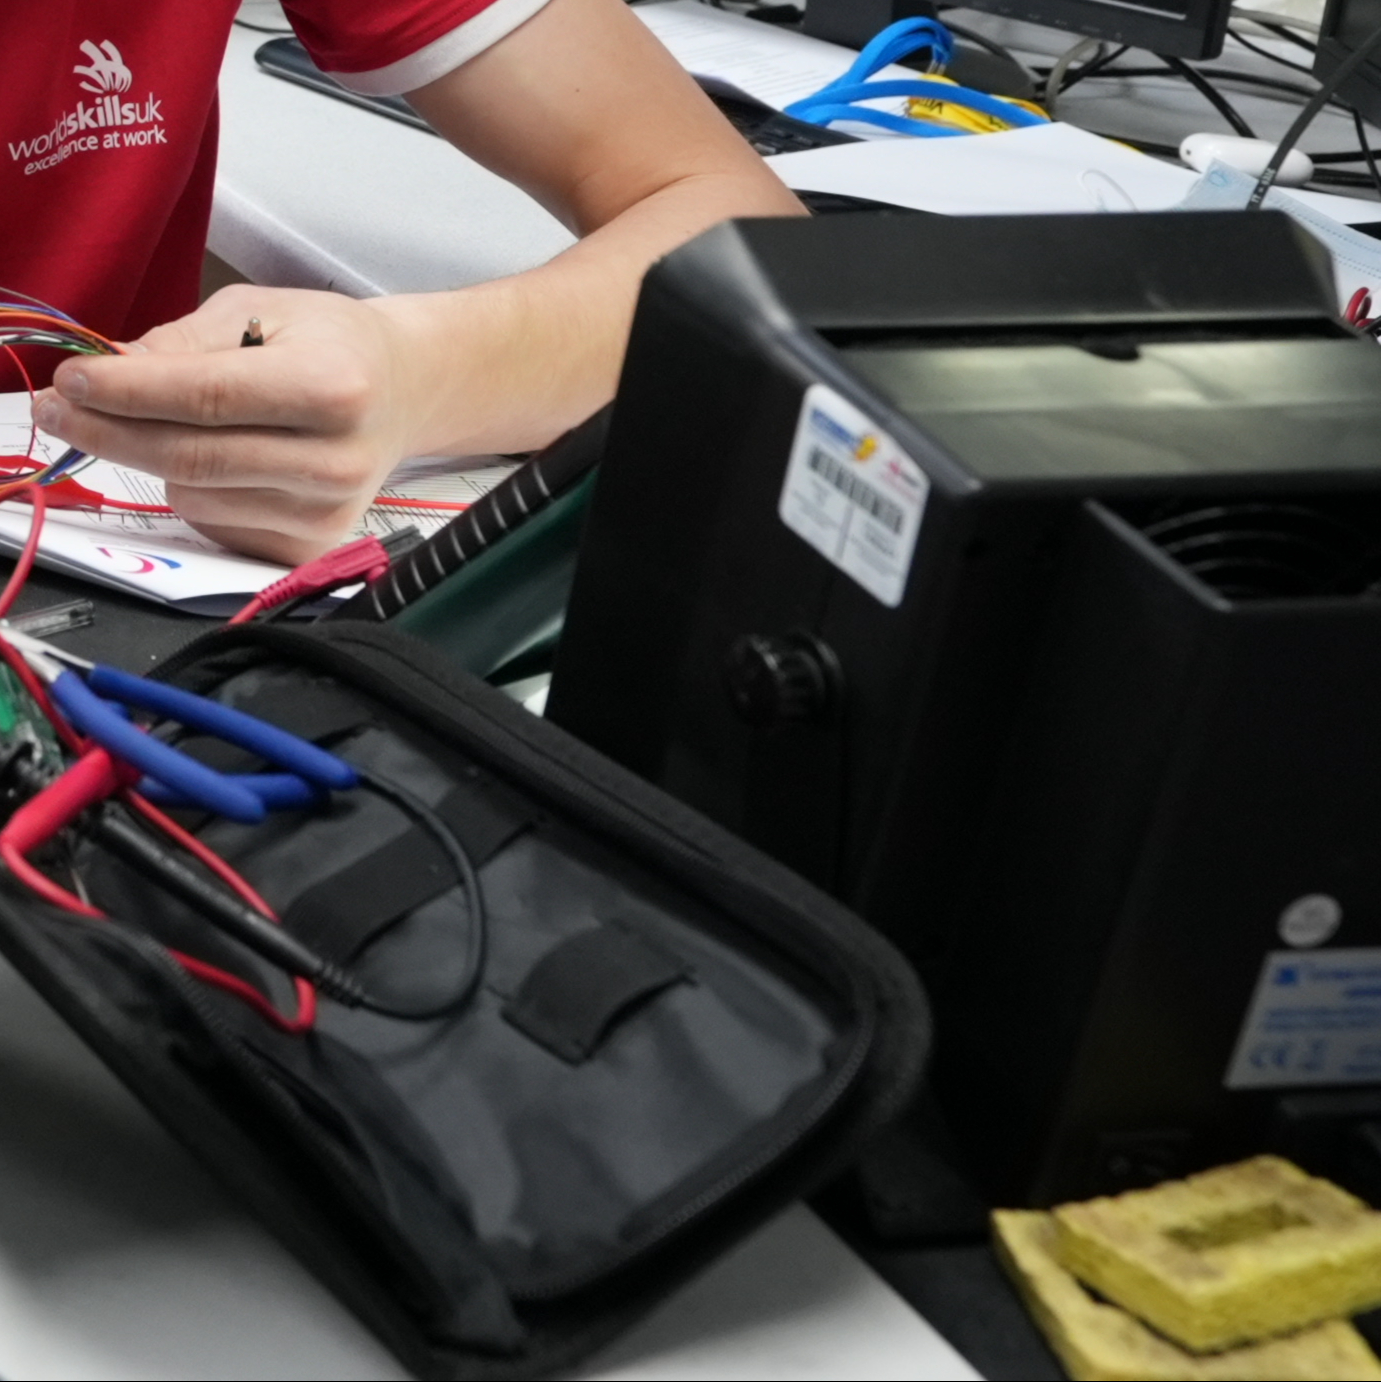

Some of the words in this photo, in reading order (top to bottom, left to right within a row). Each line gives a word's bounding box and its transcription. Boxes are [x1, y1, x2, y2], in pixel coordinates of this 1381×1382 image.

[7, 91, 165, 161] worldskillsuk
[24, 135, 99, 176] excellence
[102, 131, 121, 149] at
[123, 124, 168, 148] work
